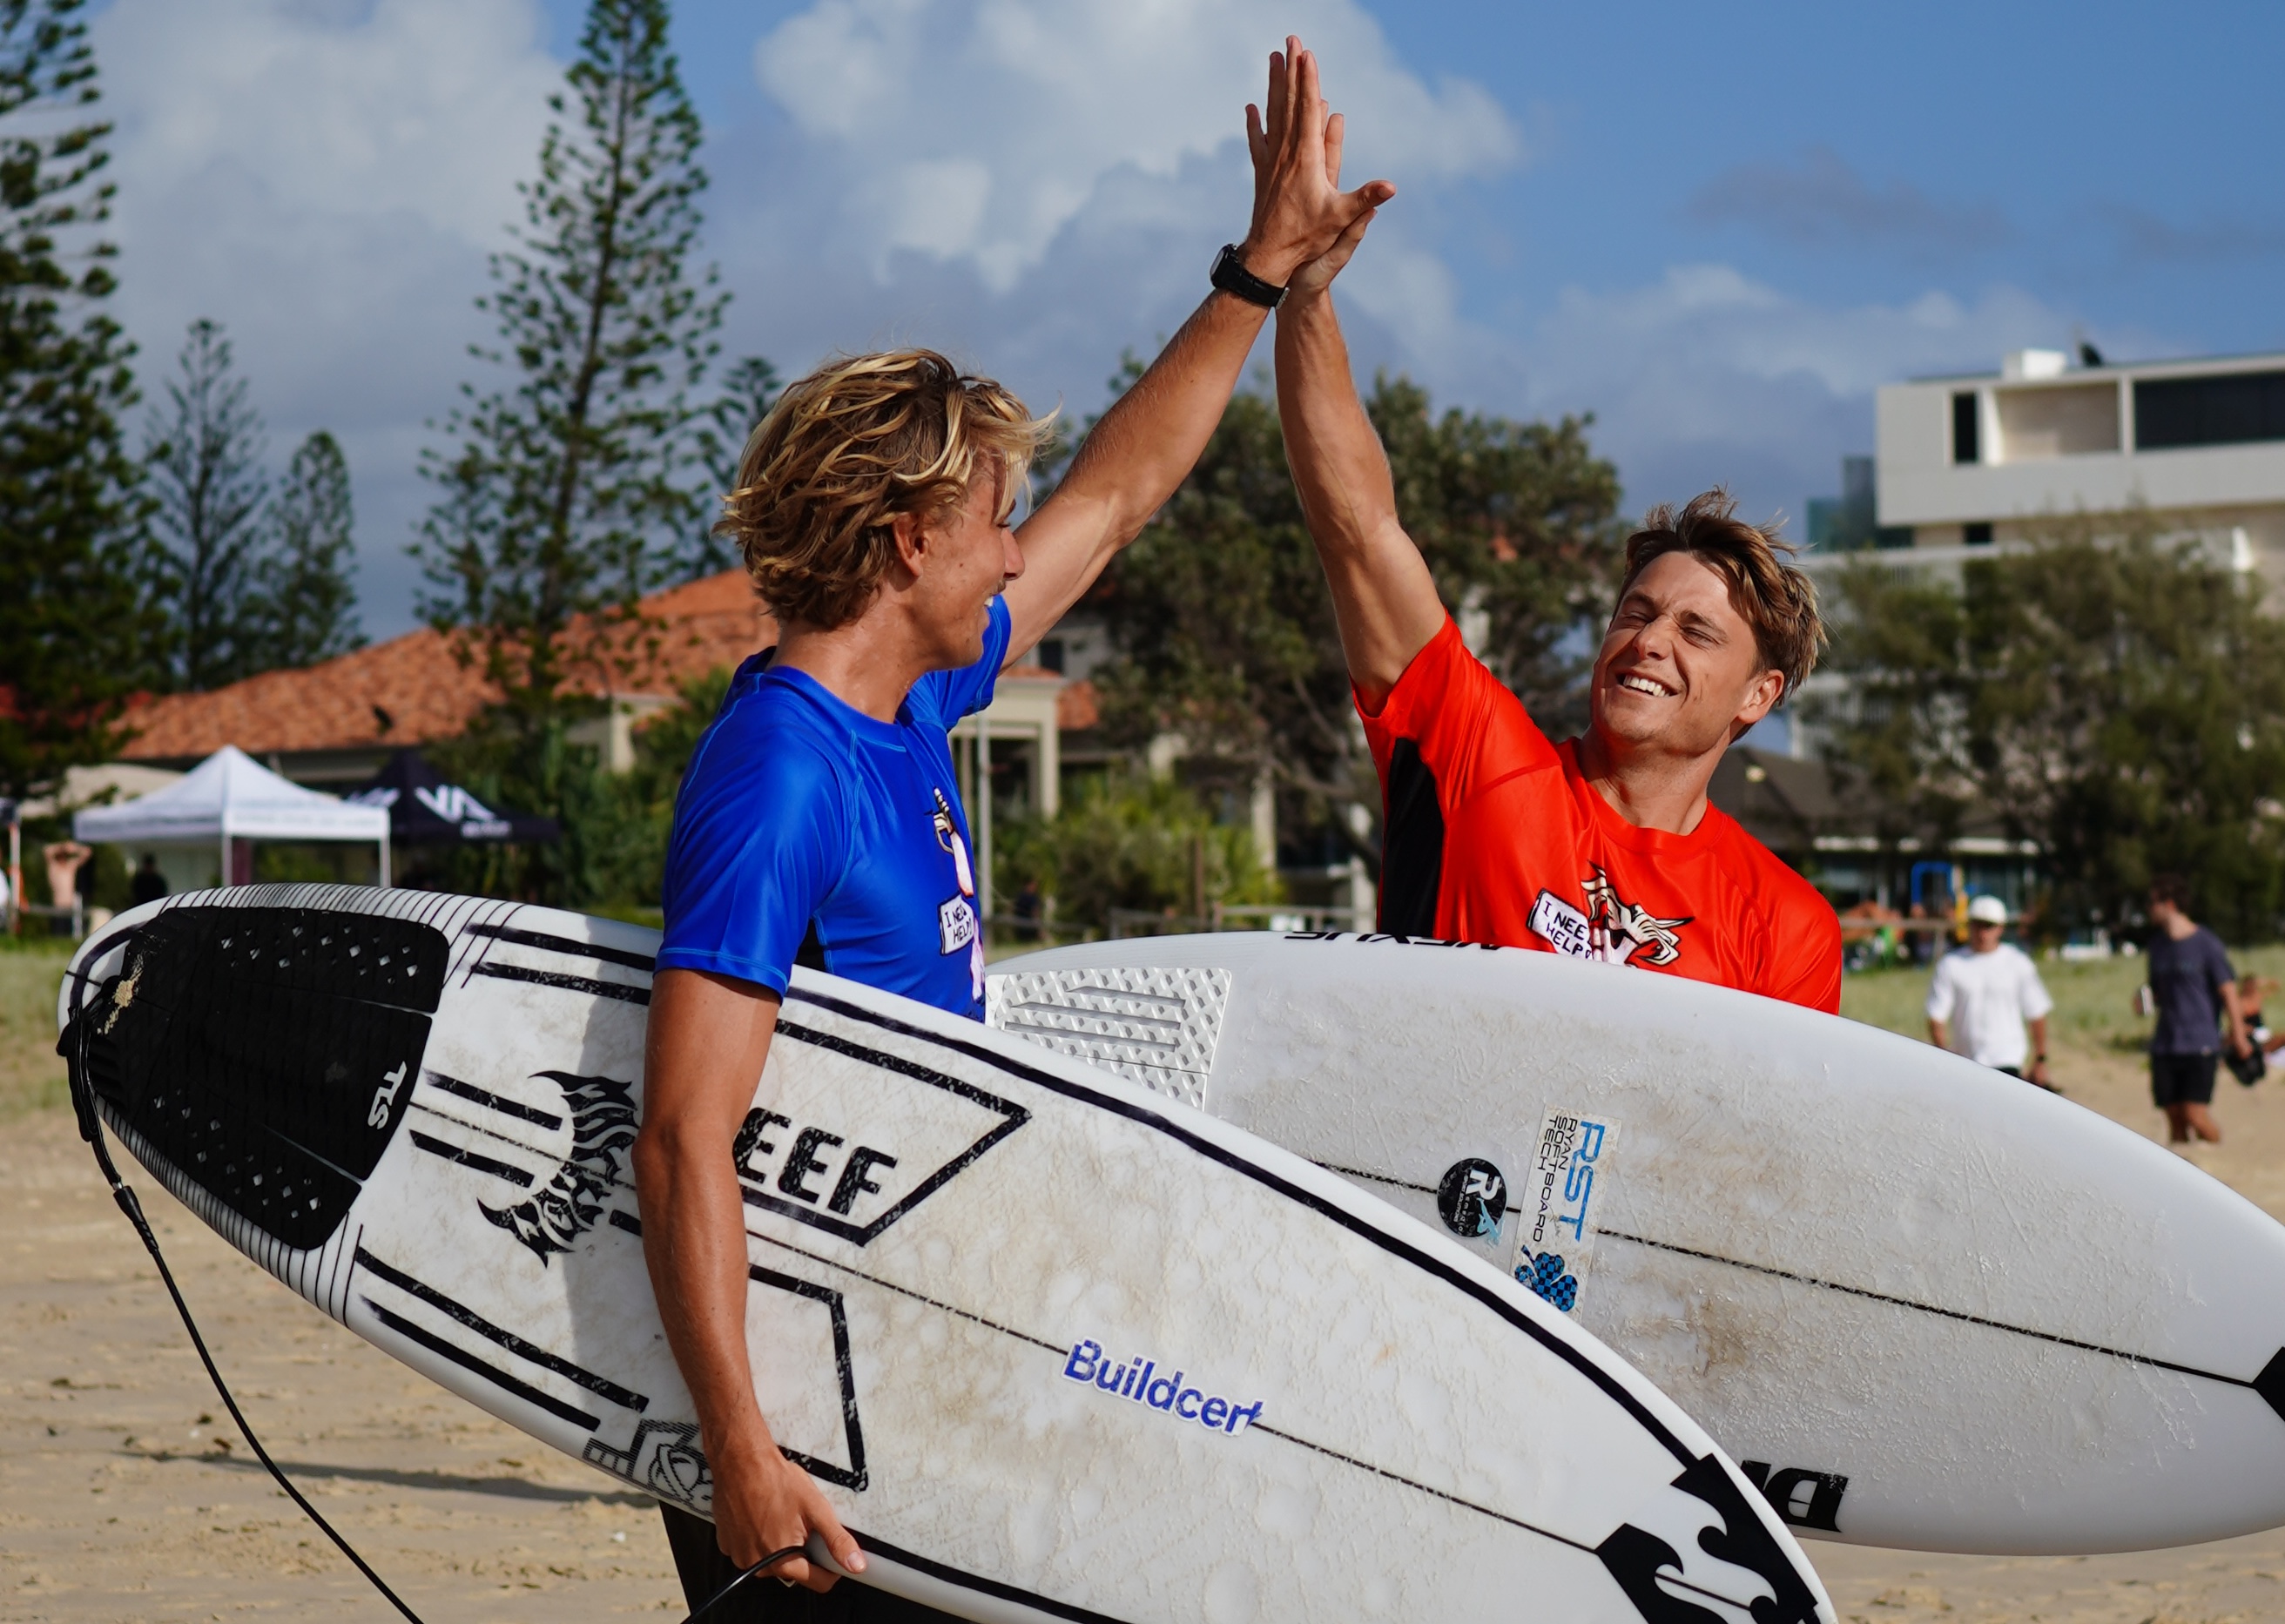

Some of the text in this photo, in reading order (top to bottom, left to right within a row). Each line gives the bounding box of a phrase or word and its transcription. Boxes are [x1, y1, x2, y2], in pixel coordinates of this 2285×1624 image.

[944, 911, 952, 928] I
[1544, 900, 1592, 945] I NEE
[731, 1107, 898, 1216] EEF
[1538, 1115, 1559, 1171] TECH
[1557, 1116, 1578, 1171] RYAN
[1559, 1120, 1606, 1243] RST
